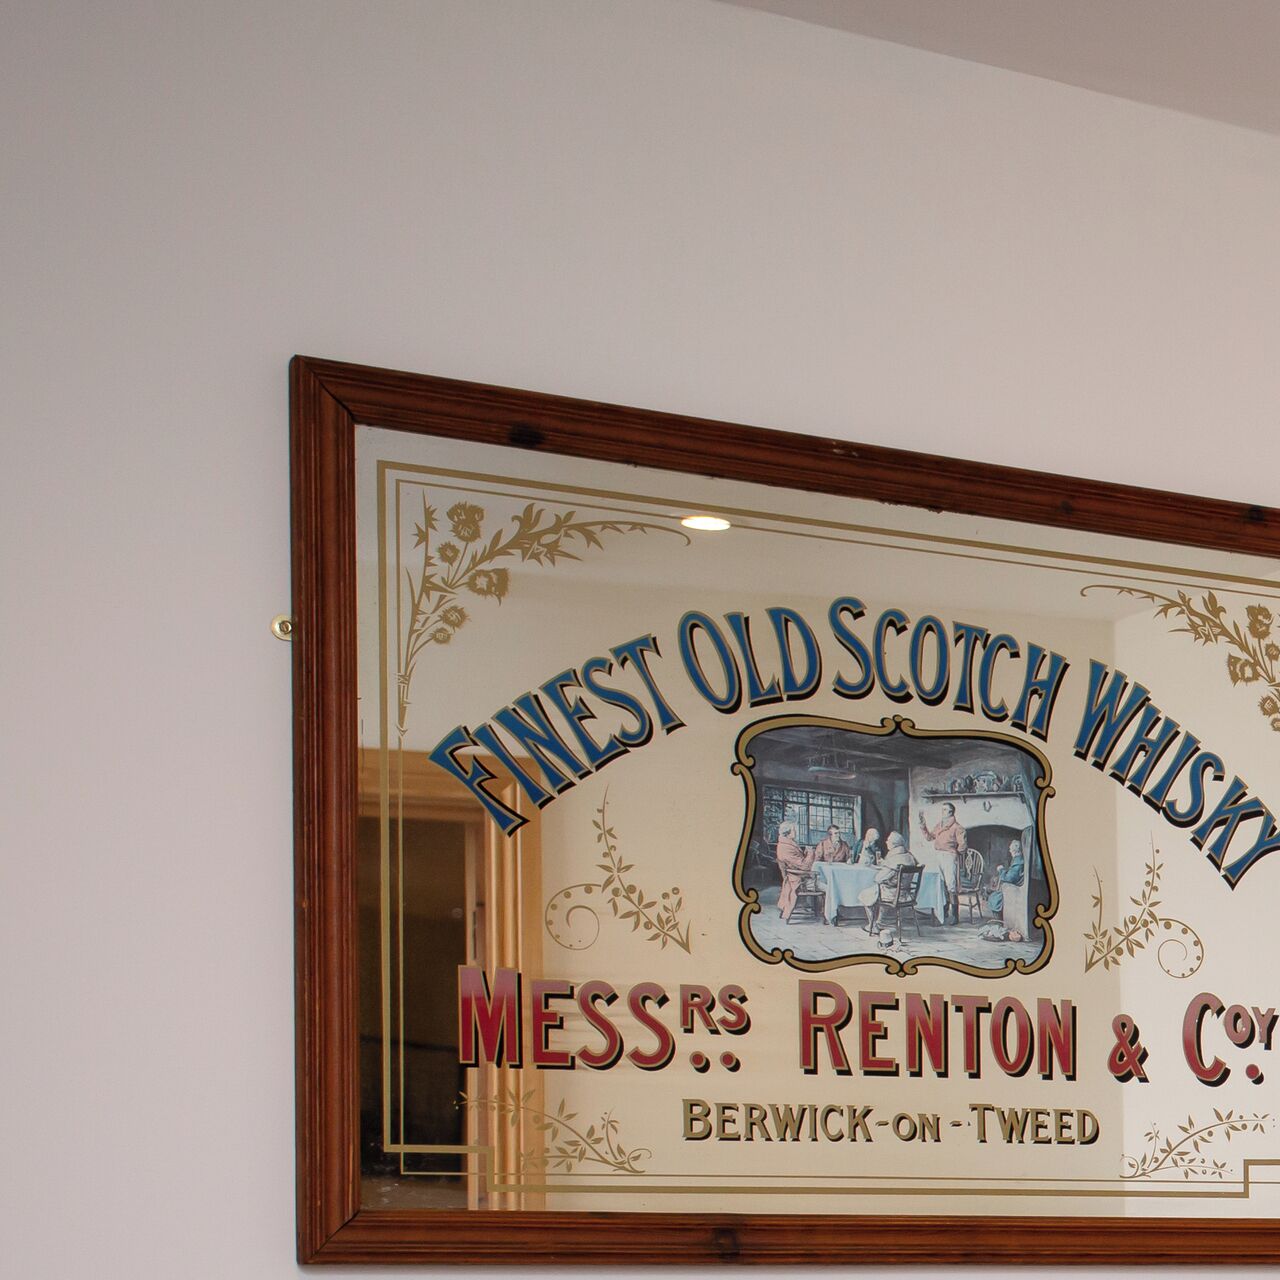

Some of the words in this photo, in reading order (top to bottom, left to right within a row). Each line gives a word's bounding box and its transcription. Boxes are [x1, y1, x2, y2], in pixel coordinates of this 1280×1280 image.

[428, 633, 687, 838] FINEST
[677, 606, 823, 714] OLD
[828, 596, 1070, 743] SCOTCH
[798, 979, 1078, 1081] RENTON
[1107, 1013, 1150, 1084] &
